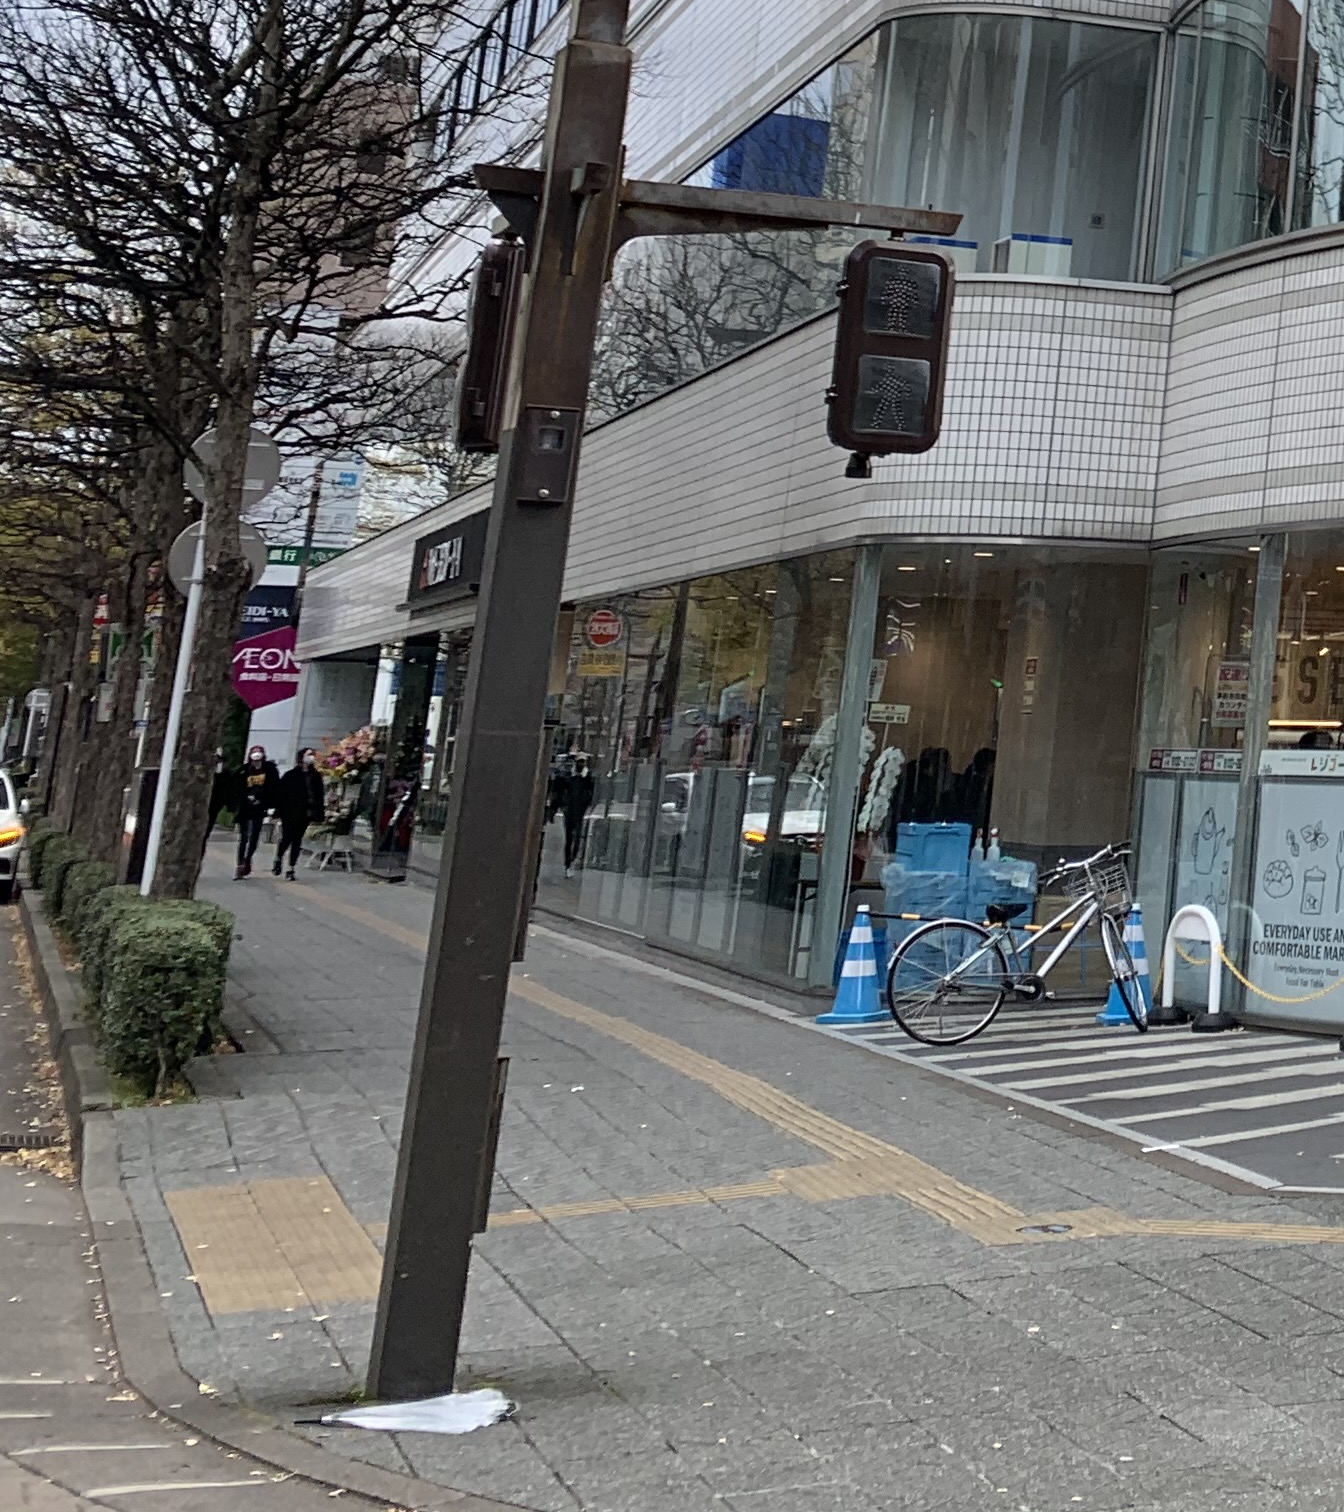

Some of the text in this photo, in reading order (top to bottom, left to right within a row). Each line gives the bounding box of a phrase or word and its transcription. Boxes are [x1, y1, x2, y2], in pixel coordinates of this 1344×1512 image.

[1263, 923, 1311, 941] EVERYDAY
[1312, 927, 1332, 943] USE
[1252, 940, 1322, 961] COMFORTABLE
